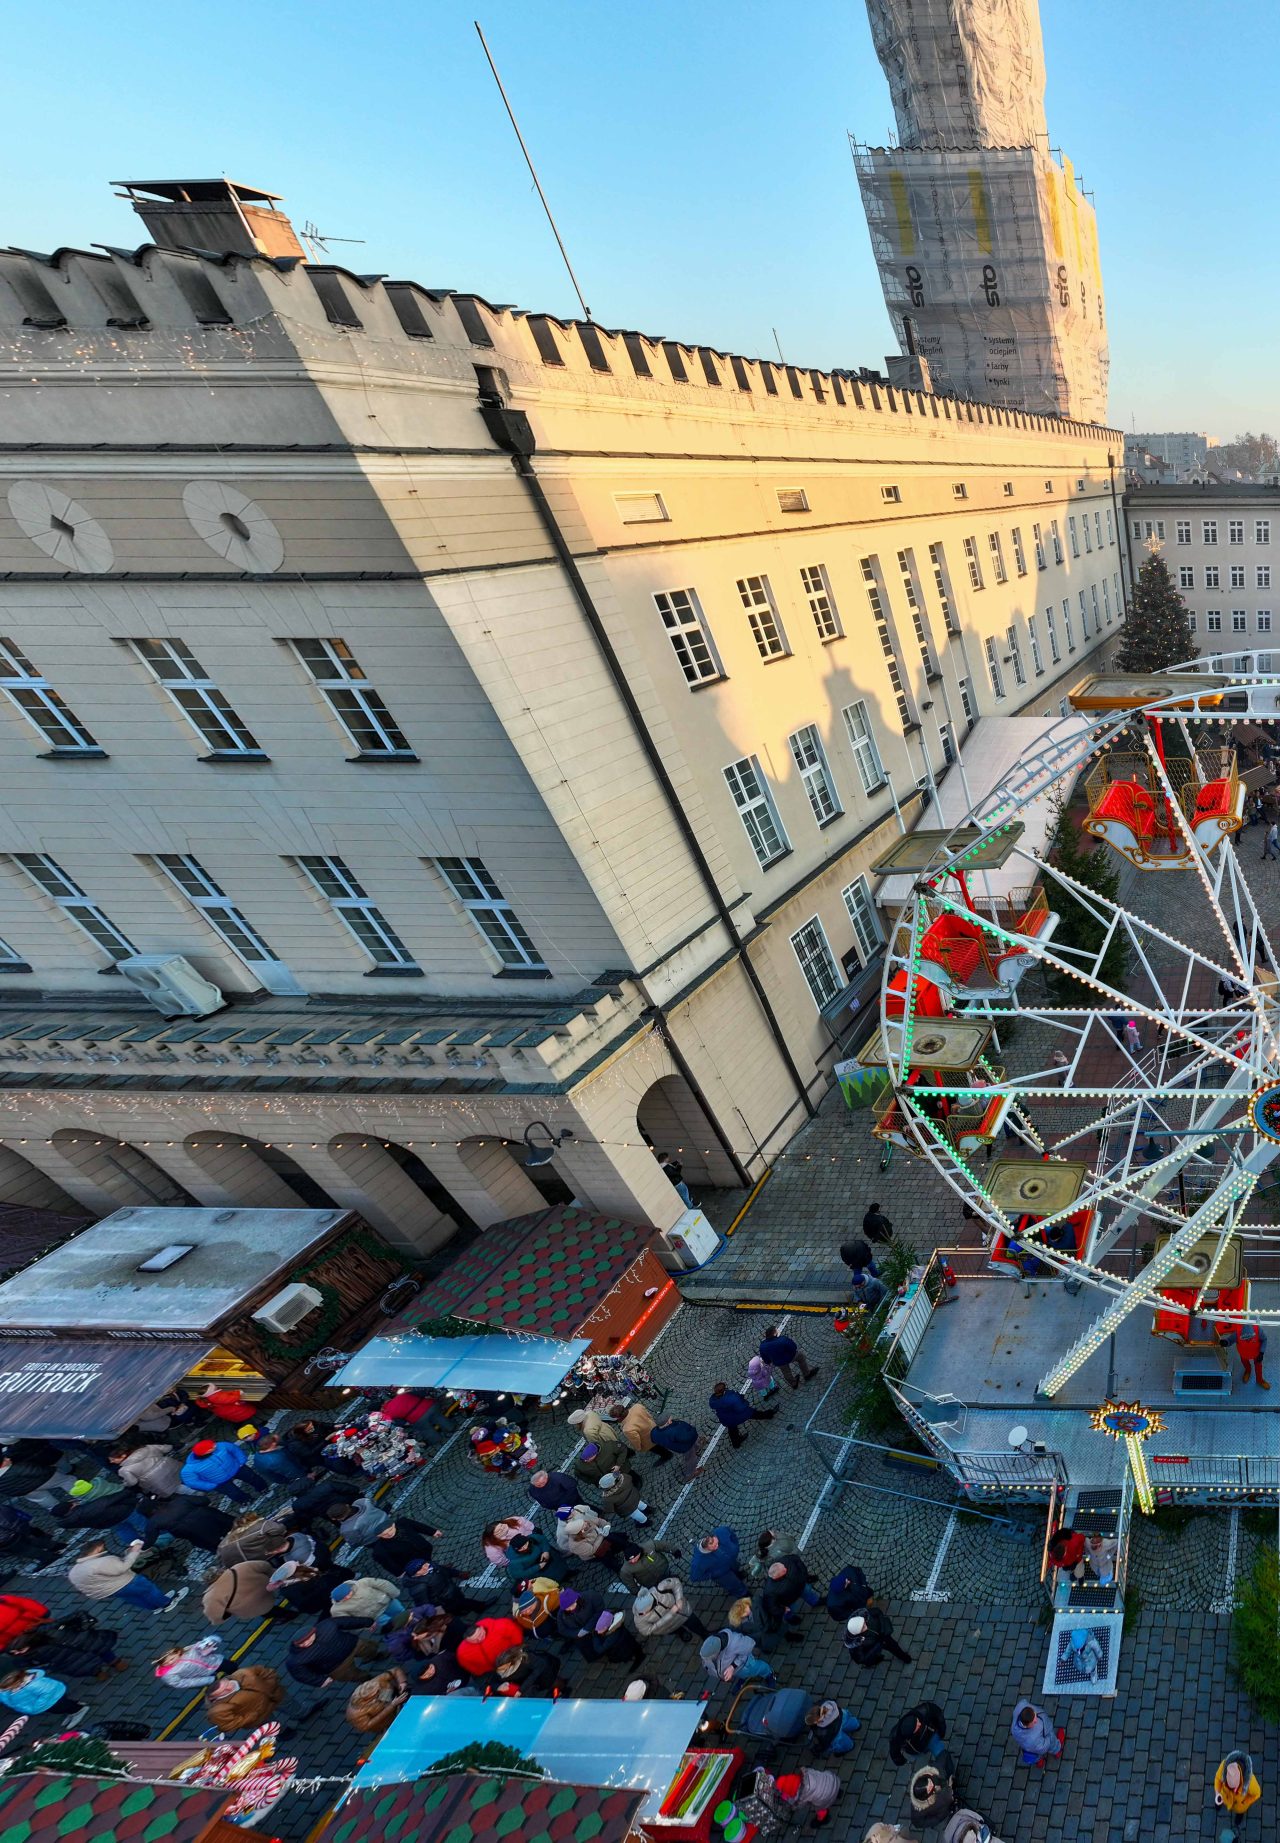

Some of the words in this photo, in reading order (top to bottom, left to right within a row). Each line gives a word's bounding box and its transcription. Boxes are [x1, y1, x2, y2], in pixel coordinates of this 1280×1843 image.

[905, 265, 925, 308] sto
[979, 264, 1000, 308] sto
[1054, 265, 1071, 308] sto
[988, 336, 1015, 346] systemy
[991, 362, 1009, 372] farby
[993, 377, 1010, 387] tynki
[153, 1331, 204, 1339] CHOCOLATE
[20, 1362, 51, 1371] FRUITS
[48, 1363, 62, 1371] IN
[57, 1363, 103, 1372] CHOCOLATE
